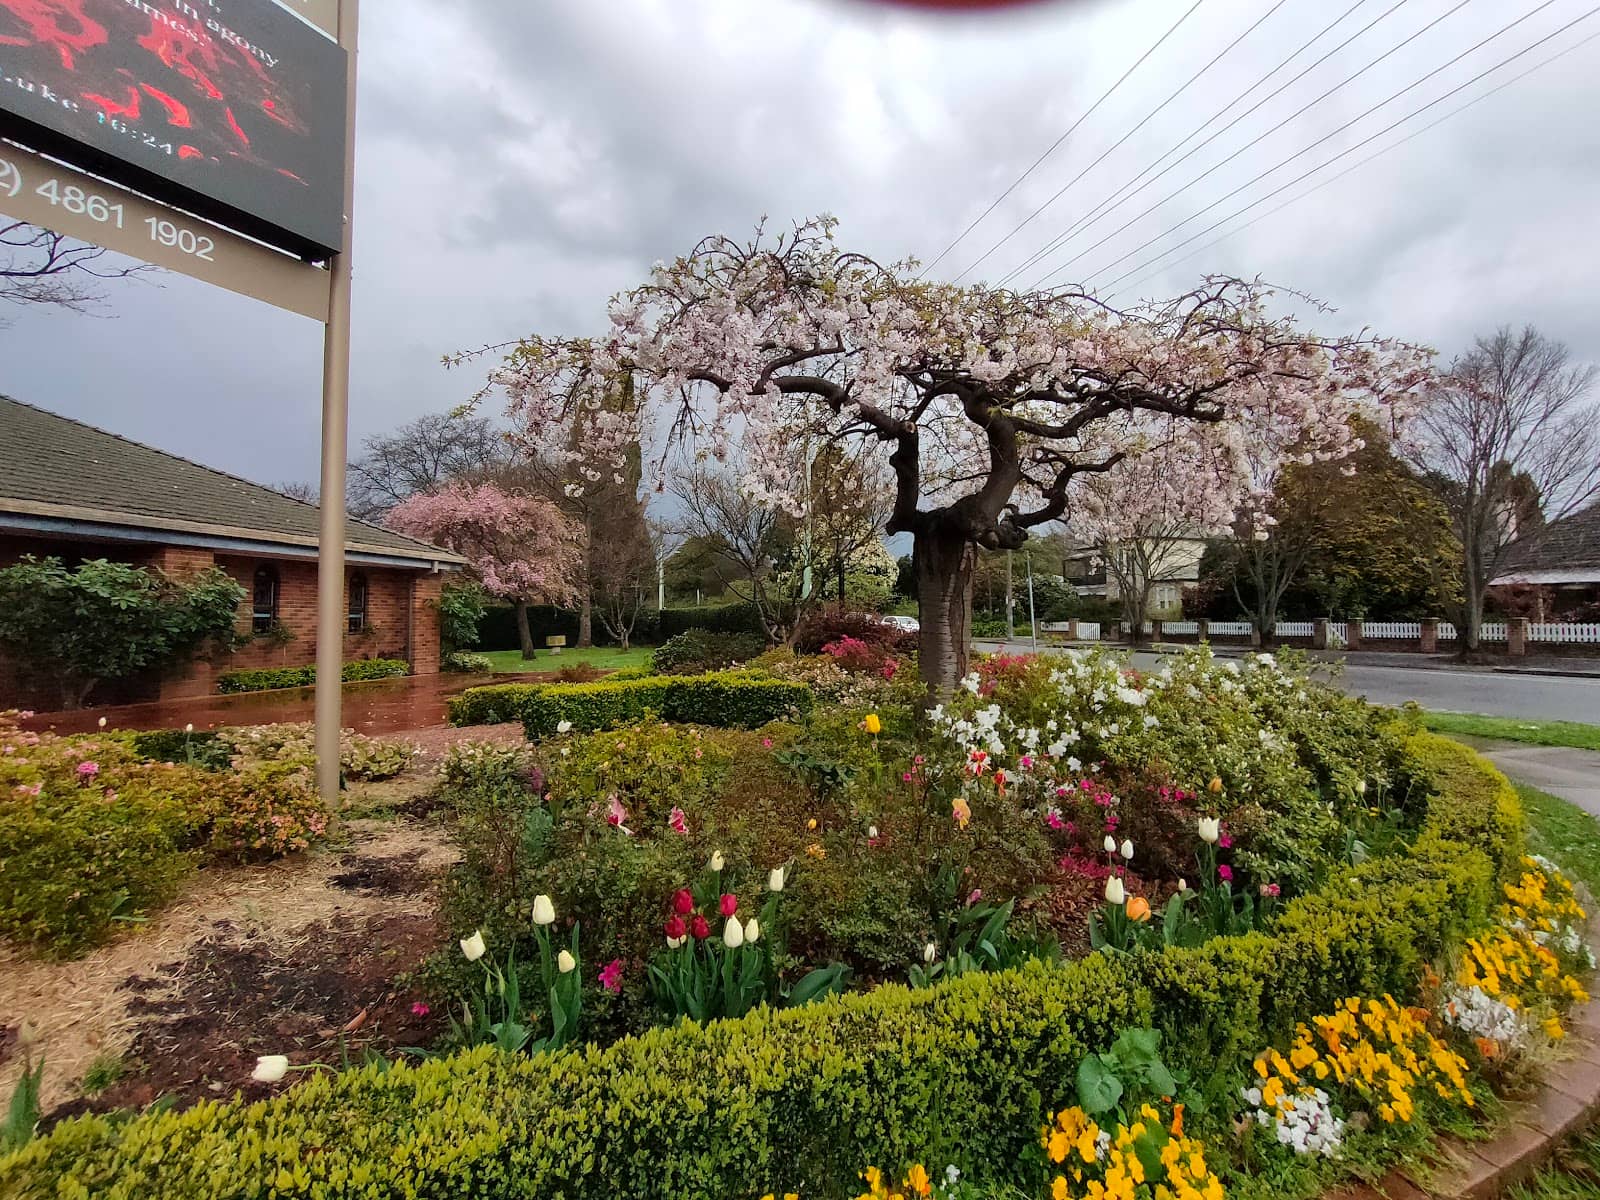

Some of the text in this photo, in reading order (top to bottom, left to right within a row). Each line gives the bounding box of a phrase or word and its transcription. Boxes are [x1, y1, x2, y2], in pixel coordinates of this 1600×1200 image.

[206, 18, 280, 68] agony
[35, 178, 125, 229] 4861
[144, 216, 215, 262] 1902
